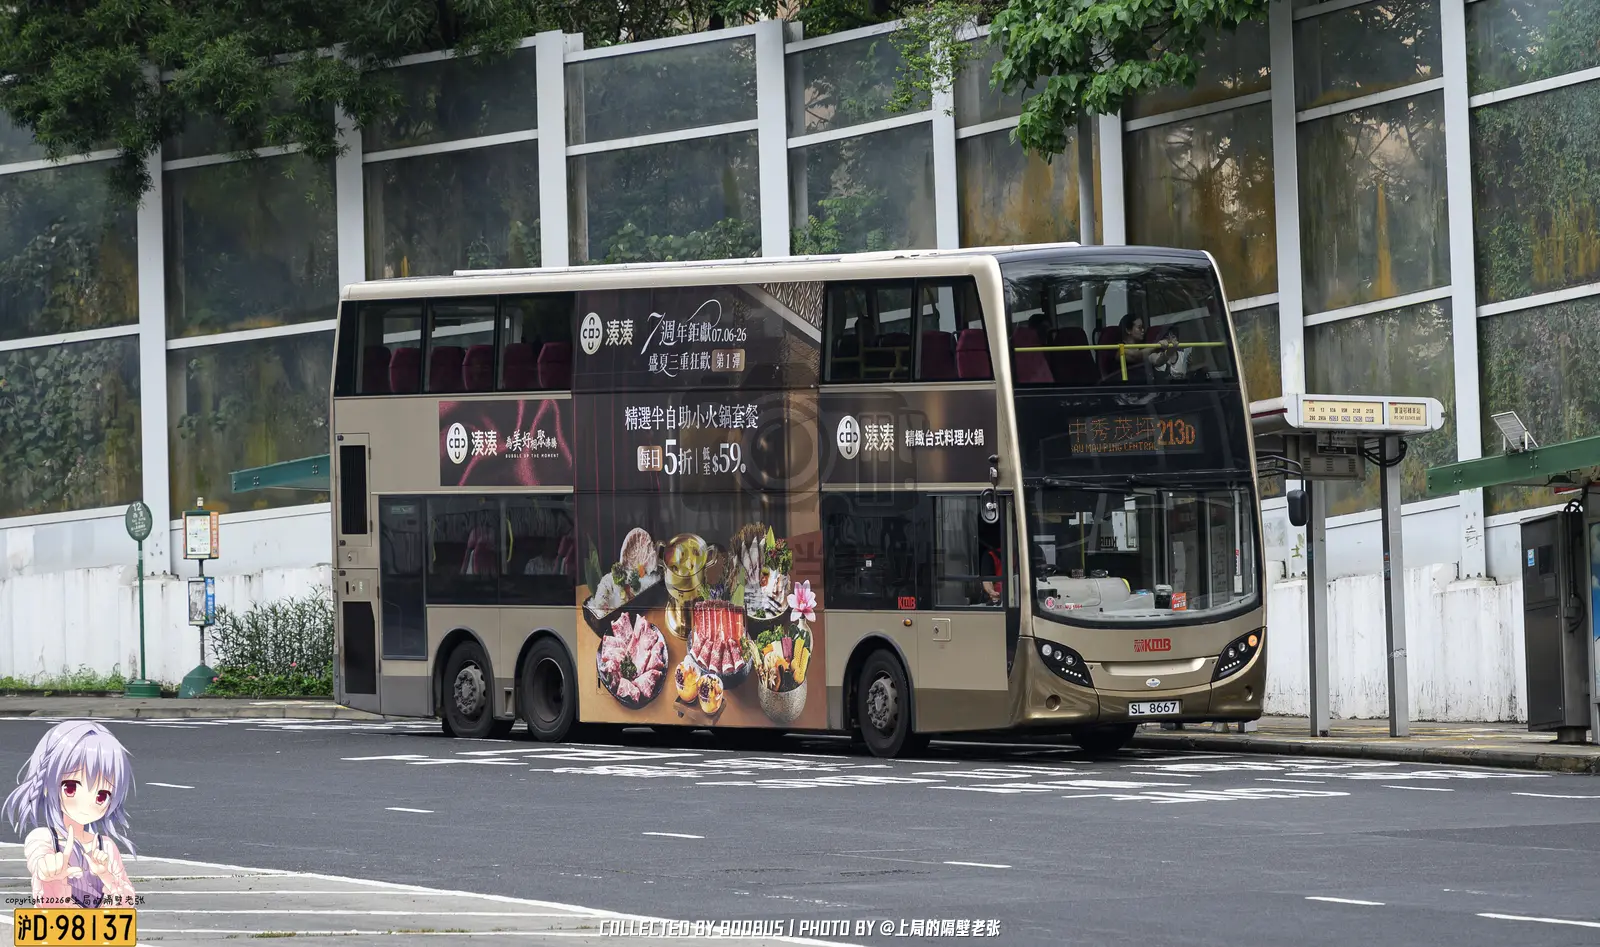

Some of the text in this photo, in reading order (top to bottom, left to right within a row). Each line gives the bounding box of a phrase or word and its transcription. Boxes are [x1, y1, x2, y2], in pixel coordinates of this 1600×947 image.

[605, 318, 634, 346] 湊湊
[648, 351, 741, 377] 盛夏三重狂歡 第1彈
[624, 404, 759, 431] 精選半自助小火鍋套餐
[1068, 416, 1156, 443] 中秀茂坪
[471, 430, 498, 456] 湊湊
[864, 423, 895, 451] 湊湊
[905, 428, 985, 447] 精緻台式料理火鍋
[1156, 418, 1197, 446] 213D
[639, 448, 661, 469] 每日
[897, 596, 917, 610] KMB
[1130, 702, 1177, 714] SL 8667
